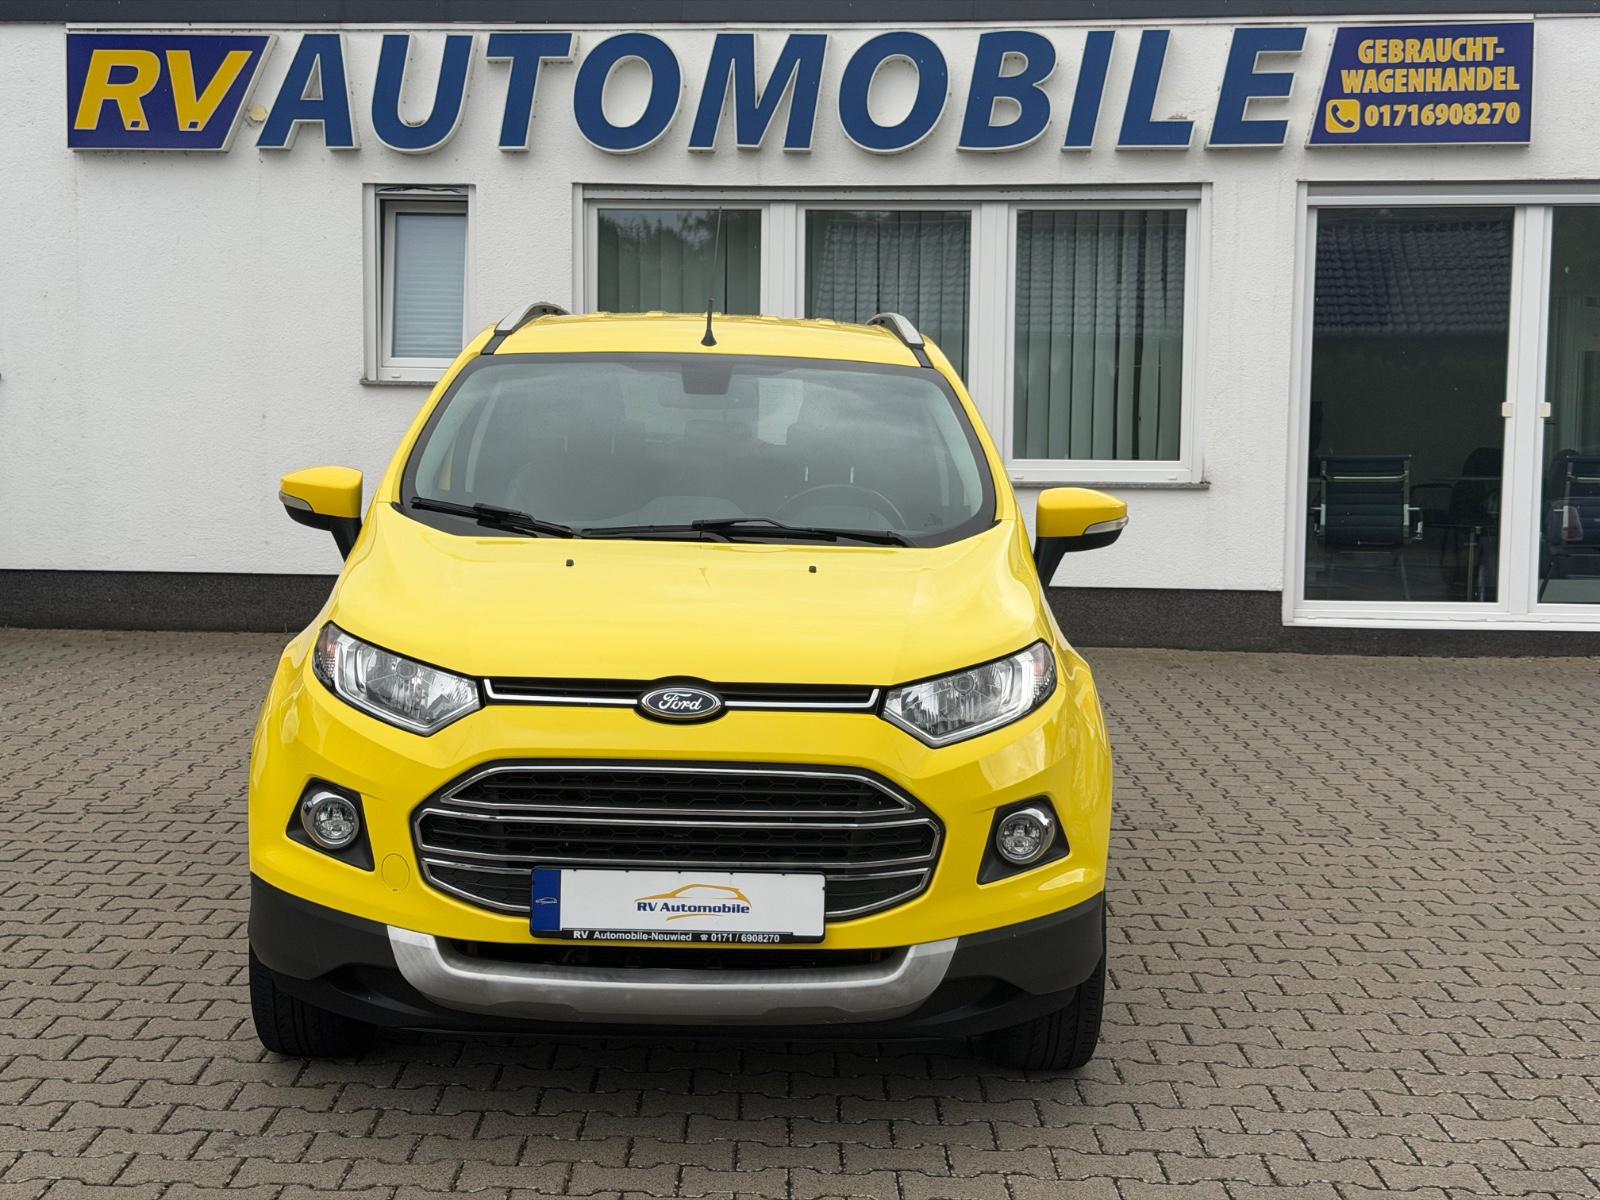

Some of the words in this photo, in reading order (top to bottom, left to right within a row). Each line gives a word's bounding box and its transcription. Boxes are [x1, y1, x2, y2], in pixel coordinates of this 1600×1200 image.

[1357, 36, 1505, 64] GEBRAUCHT-
[73, 48, 254, 132] RV
[255, 27, 1308, 154] AUTOMOBILE
[1340, 66, 1520, 94] WAGENHANDEL
[1364, 101, 1521, 127] 01716908270
[658, 692, 704, 710] Ford
[636, 901, 658, 912] RV
[659, 902, 750, 914] Automobile
[573, 930, 589, 939] RV
[593, 931, 692, 941] Automobile-Neuwied
[711, 933, 733, 942] 0171
[741, 934, 780, 943] 6908270
